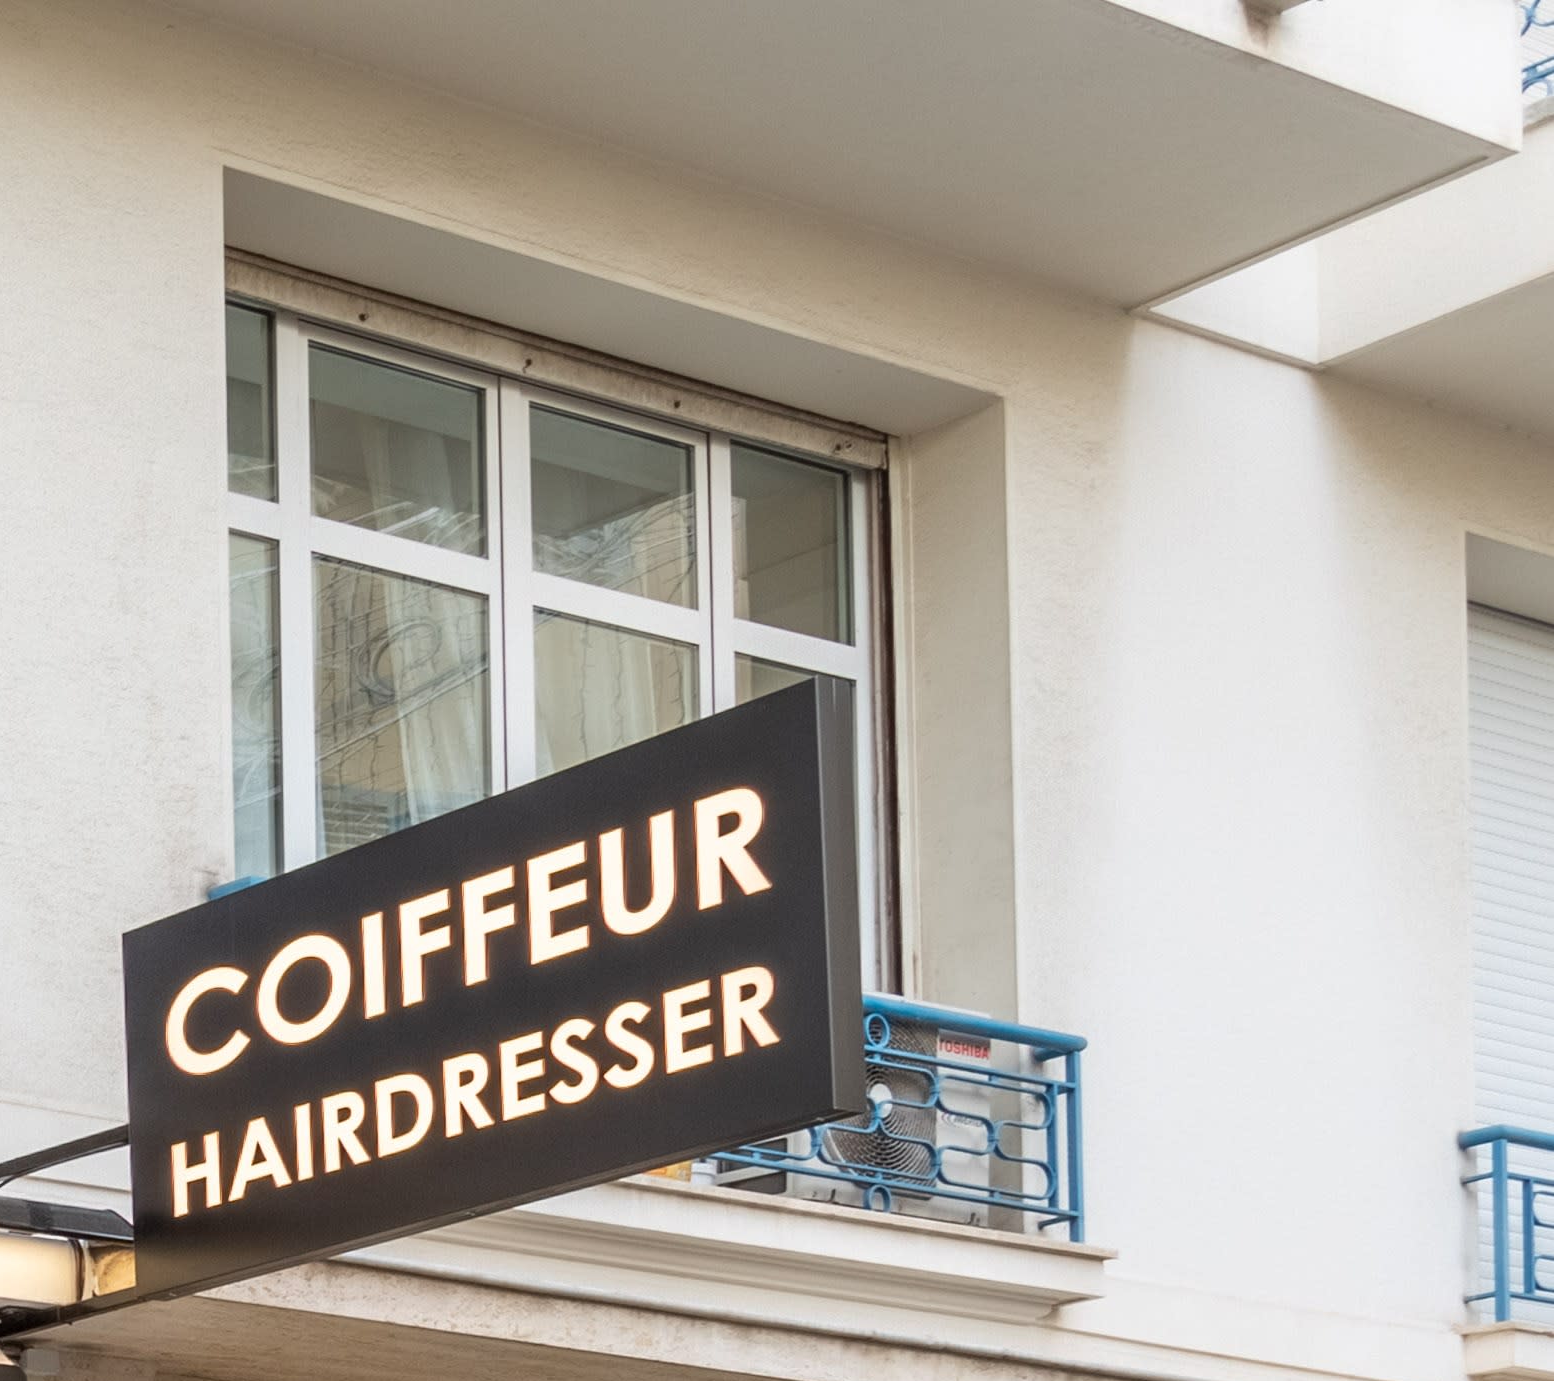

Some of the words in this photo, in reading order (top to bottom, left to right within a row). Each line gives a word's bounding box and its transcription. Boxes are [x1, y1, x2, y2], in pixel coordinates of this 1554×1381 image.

[165, 787, 773, 1076] COIFFEUR
[938, 1039, 990, 1060] TOSHIBA
[169, 965, 782, 1219] HAIRDRESSER
